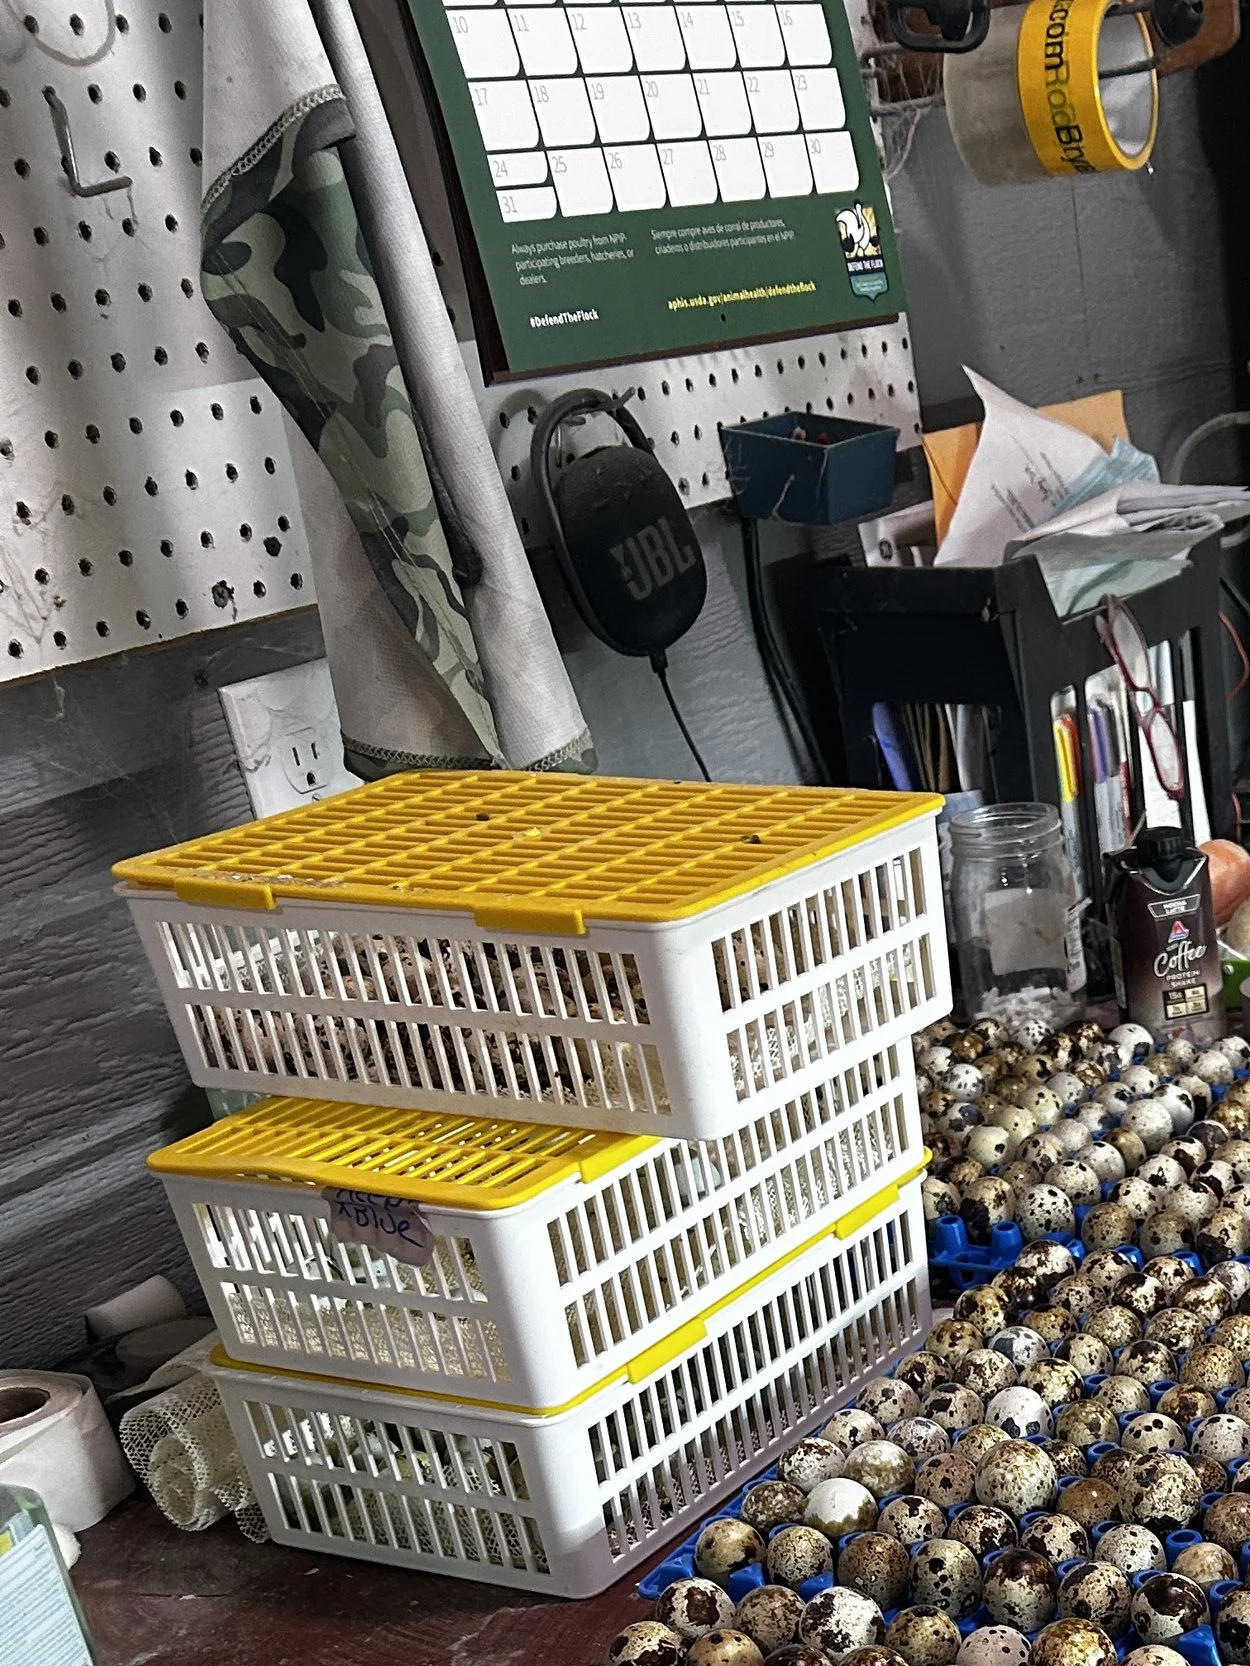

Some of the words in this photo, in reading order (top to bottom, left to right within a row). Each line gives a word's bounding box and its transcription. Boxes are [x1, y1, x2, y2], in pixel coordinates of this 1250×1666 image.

[453, 16, 469, 34] 10
[513, 14, 529, 32] 11
[571, 13, 588, 31] 12
[627, 12, 642, 29] 13
[681, 12, 694, 28] 14
[732, 10, 745, 27] 15
[780, 10, 793, 26] 16
[590, 82, 606, 101] 19
[644, 80, 659, 98] 20
[697, 78, 710, 95] 21
[748, 76, 760, 93] 22
[796, 74, 808, 91] 23
[474, 87, 489, 106] 17
[533, 85, 550, 104] 18
[713, 144, 727, 162] 28
[763, 141, 775, 158] 29
[809, 138, 822, 154] 30
[552, 155, 568, 174] 25
[608, 152, 623, 170] 26
[662, 148, 674, 166] 27
[493, 159, 509, 178] 24
[502, 196, 518, 214] 31
[536, 240, 567, 253] purchase
[568, 236, 593, 250] poultry
[514, 255, 560, 272] participating
[519, 273, 547, 286] dealers.
[668, 280, 817, 311] aphis.usda.gov/animalhealth/defendtheflock
[530, 309, 599, 328] #DefendTheFlock
[624, 516, 697, 600] JBL
[1154, 940, 1207, 977] Coffee
[1166, 970, 1200, 981] PROTEIN
[1171, 978, 1197, 988] SHAKE
